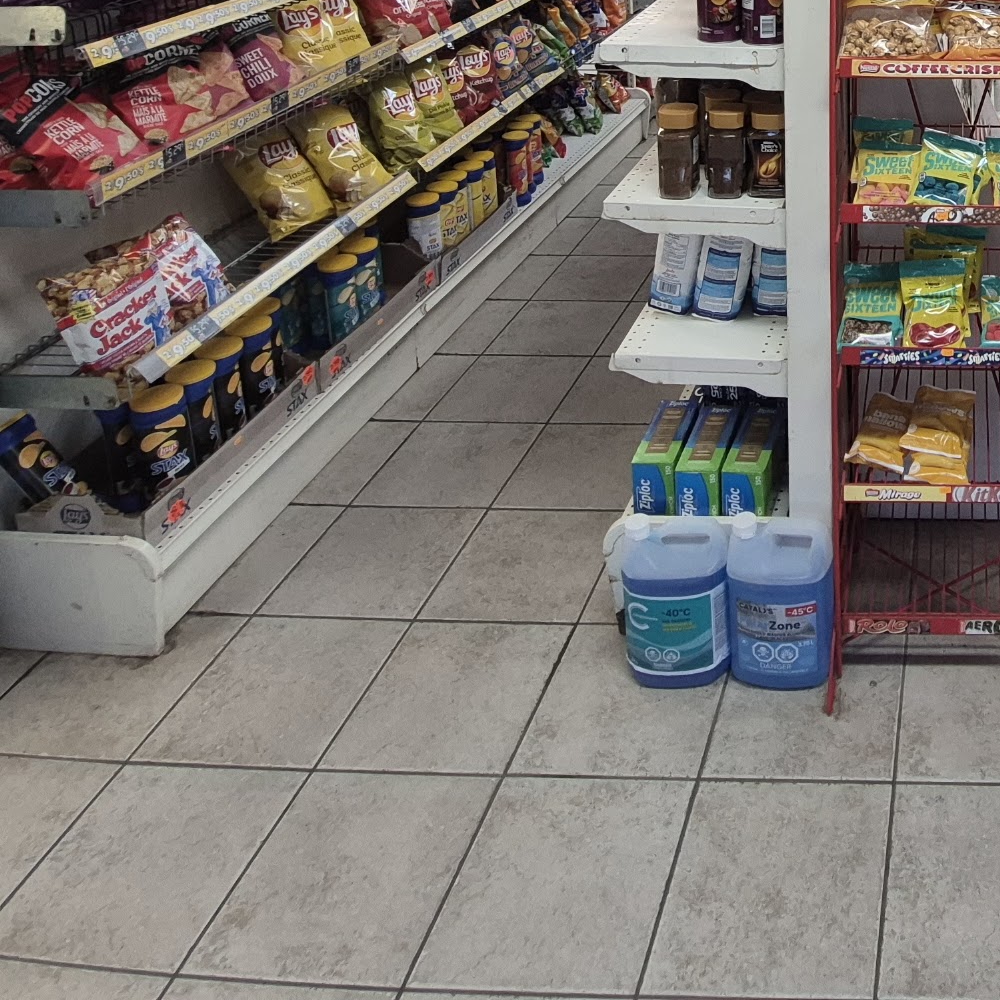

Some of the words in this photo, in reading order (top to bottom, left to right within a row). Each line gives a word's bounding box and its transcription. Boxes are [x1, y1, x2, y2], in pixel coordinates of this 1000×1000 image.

[281, 6, 319, 30] Lay's
[235, 48, 263, 67] SWEET
[240, 57, 272, 79] CHILI
[458, 50, 490, 72] Lay's
[247, 69, 278, 89] DOUX
[883, 64, 949, 75] COFFEE
[128, 86, 162, 99] KETTLE
[414, 76, 441, 98] Lay's
[470, 77, 494, 88] Ketchup
[2, 95, 33, 123] POP
[131, 94, 163, 106] CORN
[44, 116, 77, 138] KETTLE
[135, 113, 168, 127] MARMITE
[52, 124, 86, 146] CORN
[71, 140, 104, 162] MARMITE
[284, 167, 310, 182] Classic
[426, 243, 440, 252] STAX
[90, 285, 157, 339] Cracker
[97, 317, 144, 355] Jack
[883, 351, 920, 365] SMARTIES
[151, 448, 191, 476] STAX
[639, 479, 652, 510] Ziploc
[682, 487, 694, 517] Ziploc
[728, 487, 740, 517] Ziploc
[878, 488, 921, 501] Mirage
[769, 621, 801, 631] Zone
[857, 619, 908, 634] Rolo
[759, 662, 793, 671] DANGER
